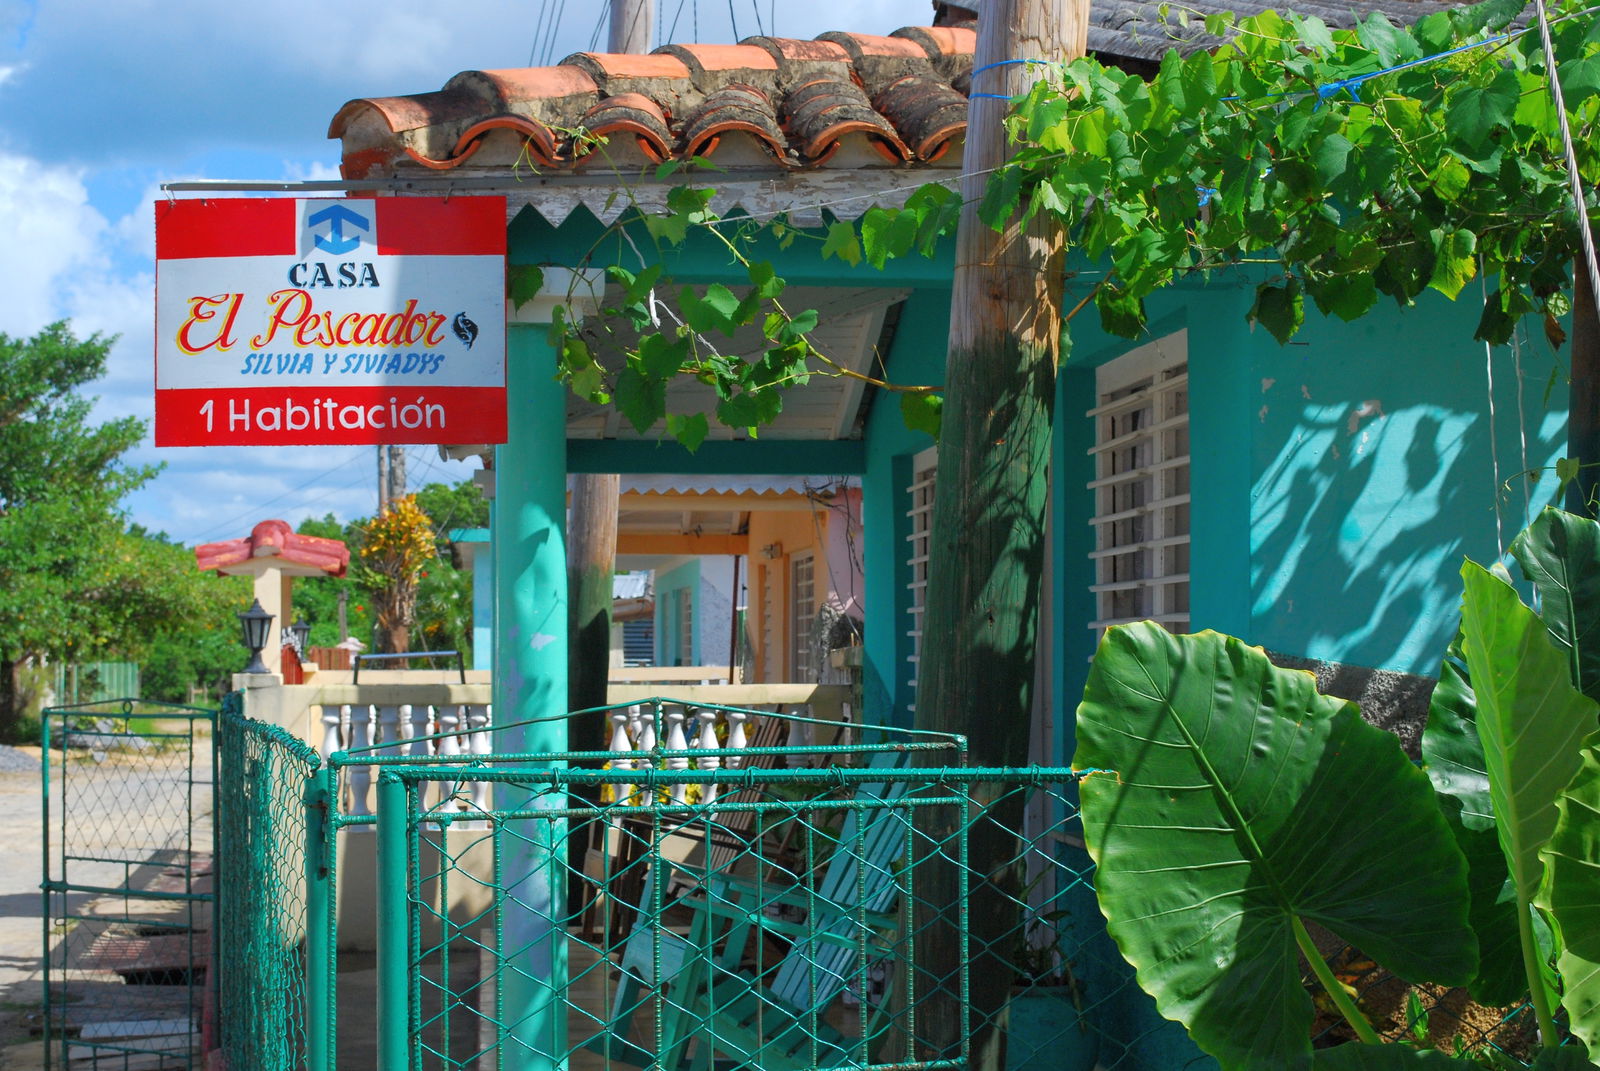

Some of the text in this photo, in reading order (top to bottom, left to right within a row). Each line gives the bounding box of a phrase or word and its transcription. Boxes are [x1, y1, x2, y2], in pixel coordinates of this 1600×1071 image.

[287, 261, 381, 289] CASA
[175, 288, 448, 356] El Pescador
[240, 352, 446, 376] SILVIA Y SIVIADYS
[199, 395, 446, 432] 1 Habitación
